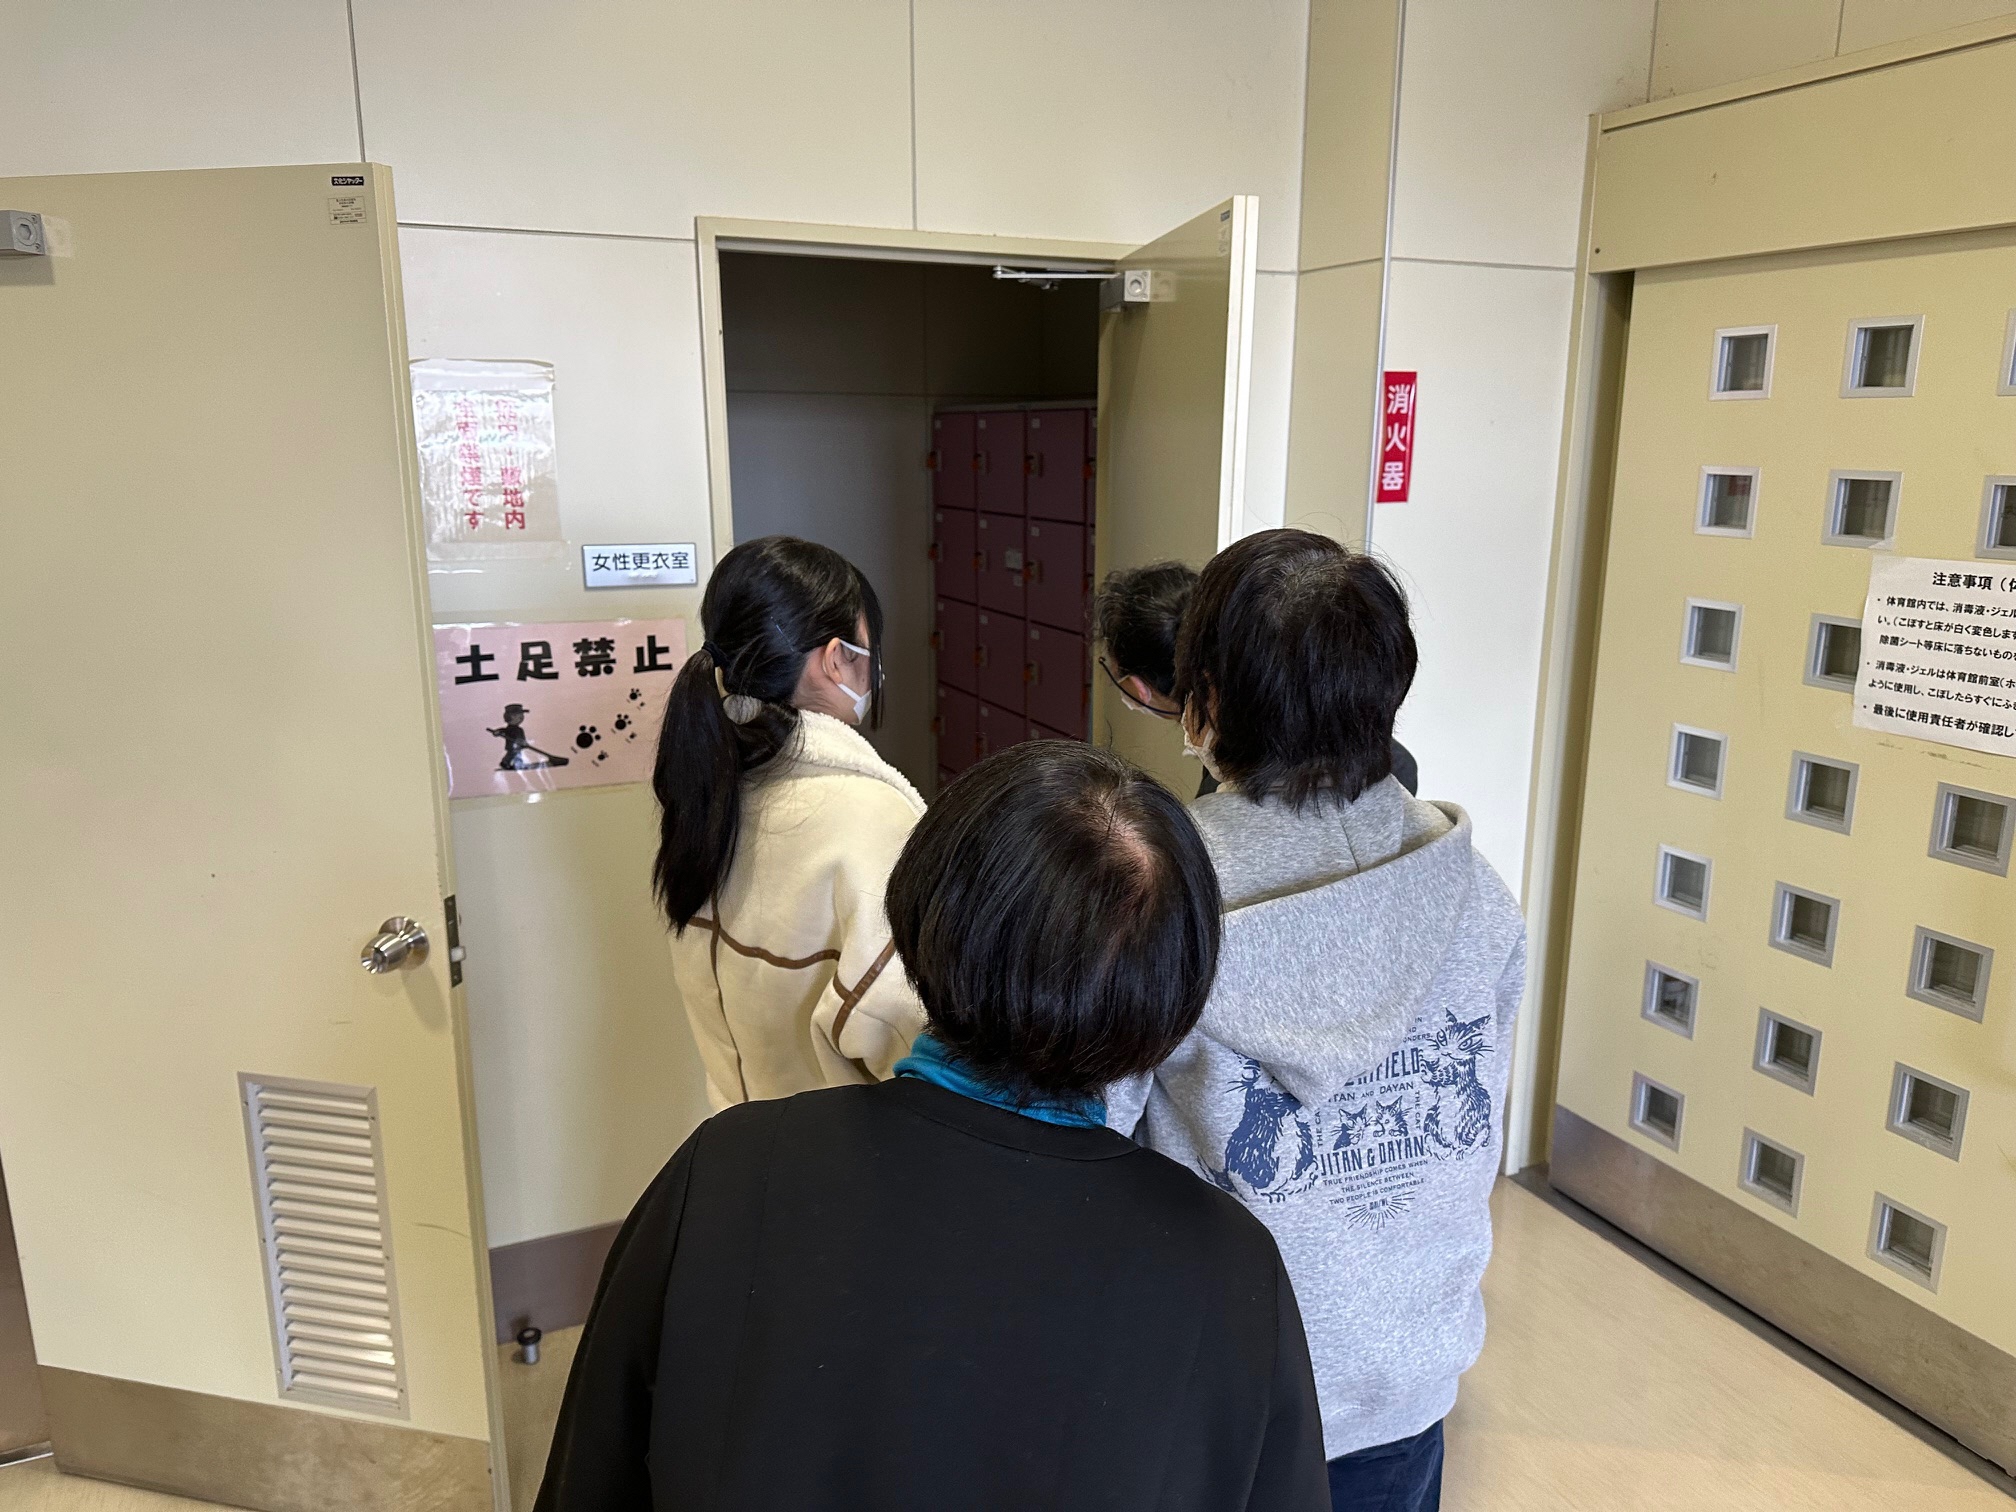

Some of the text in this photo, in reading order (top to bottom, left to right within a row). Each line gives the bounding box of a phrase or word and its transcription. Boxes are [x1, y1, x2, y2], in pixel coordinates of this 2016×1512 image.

[1381, 383, 1411, 491] 消火器
[592, 551, 689, 572] 女性更衣室
[455, 635, 673, 685] 土足禁止
[1879, 634, 2016, 661] 除菌シート等床に落ちないもの
[1873, 703, 2016, 738] 最後に使用責任者が確認し
[1328, 1092, 1356, 1103] TAN
[1380, 1081, 1414, 1095] DAYAN
[1320, 1148, 1362, 1176] JITAN
[1378, 1135, 1425, 1164] DAYAN
[1323, 1159, 1428, 1186] TRUE FRIENDSHIP COMES WHEN
[1341, 1171, 1414, 1193] THE SILENCE BETWEEN
[1330, 1197, 1344, 1205] TWO
[1346, 1191, 1371, 1202] PEOPLE
